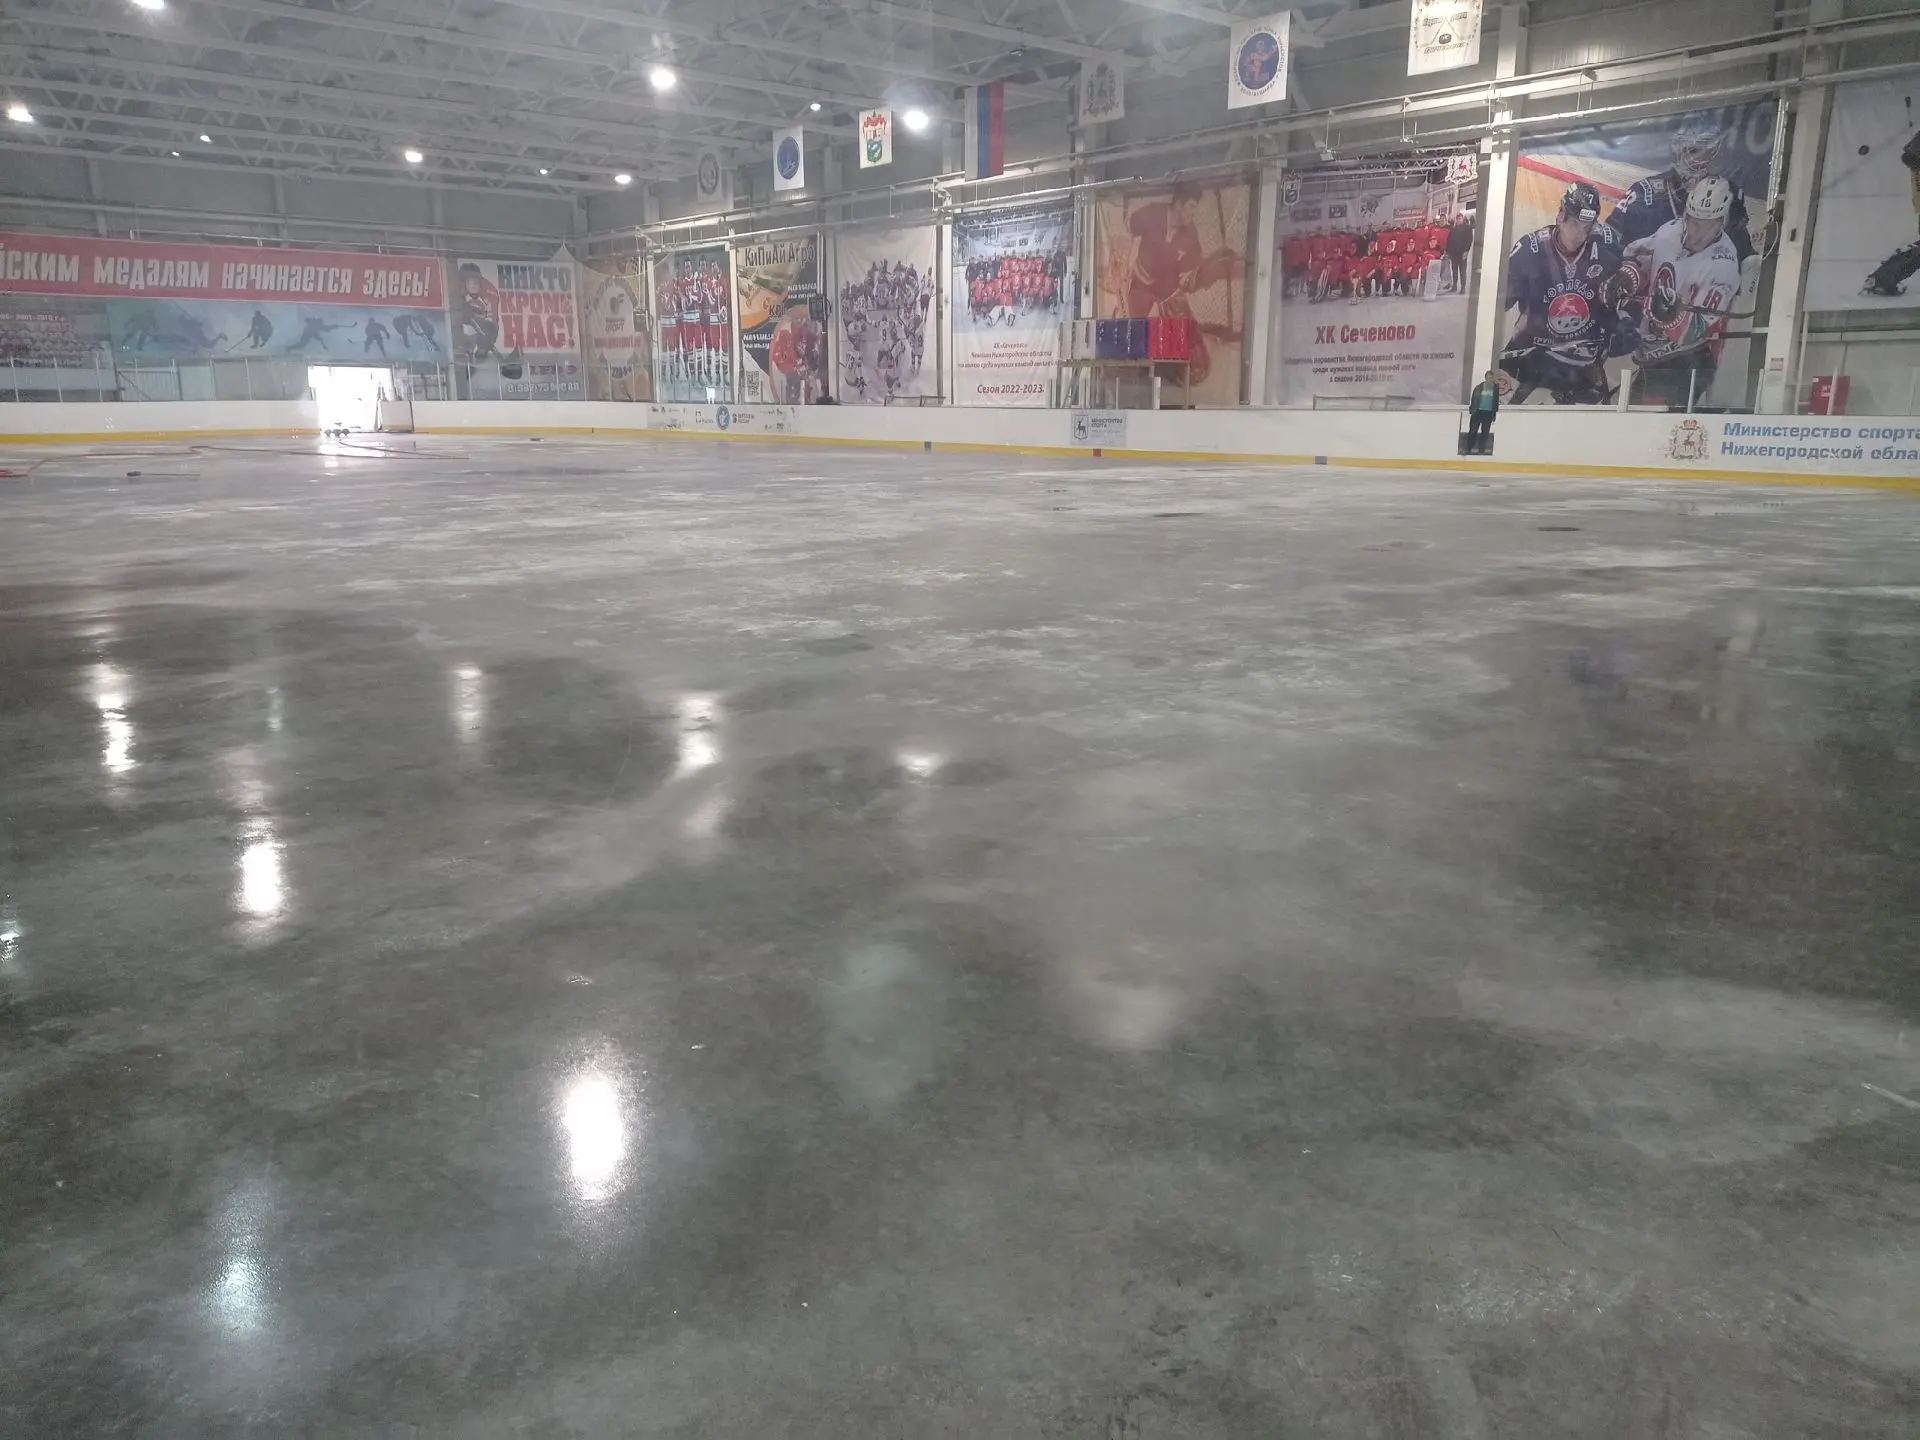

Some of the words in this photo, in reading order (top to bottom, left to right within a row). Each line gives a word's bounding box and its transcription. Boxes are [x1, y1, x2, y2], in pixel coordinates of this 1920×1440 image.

[93, 256, 210, 290] медалям
[221, 262, 353, 294] начинается
[362, 266, 431, 299] здесь!
[497, 263, 572, 291] НИКТО
[499, 290, 573, 314] КРОМЕ
[502, 314, 576, 349] НАС!
[1315, 325, 1336, 345] ХК
[1340, 324, 1416, 344] Сеченово
[977, 384, 1000, 394] Сезон
[1723, 422, 1852, 441] Министерство
[1720, 440, 1863, 460] Нижегородской
[1870, 445, 1920, 461] обла
